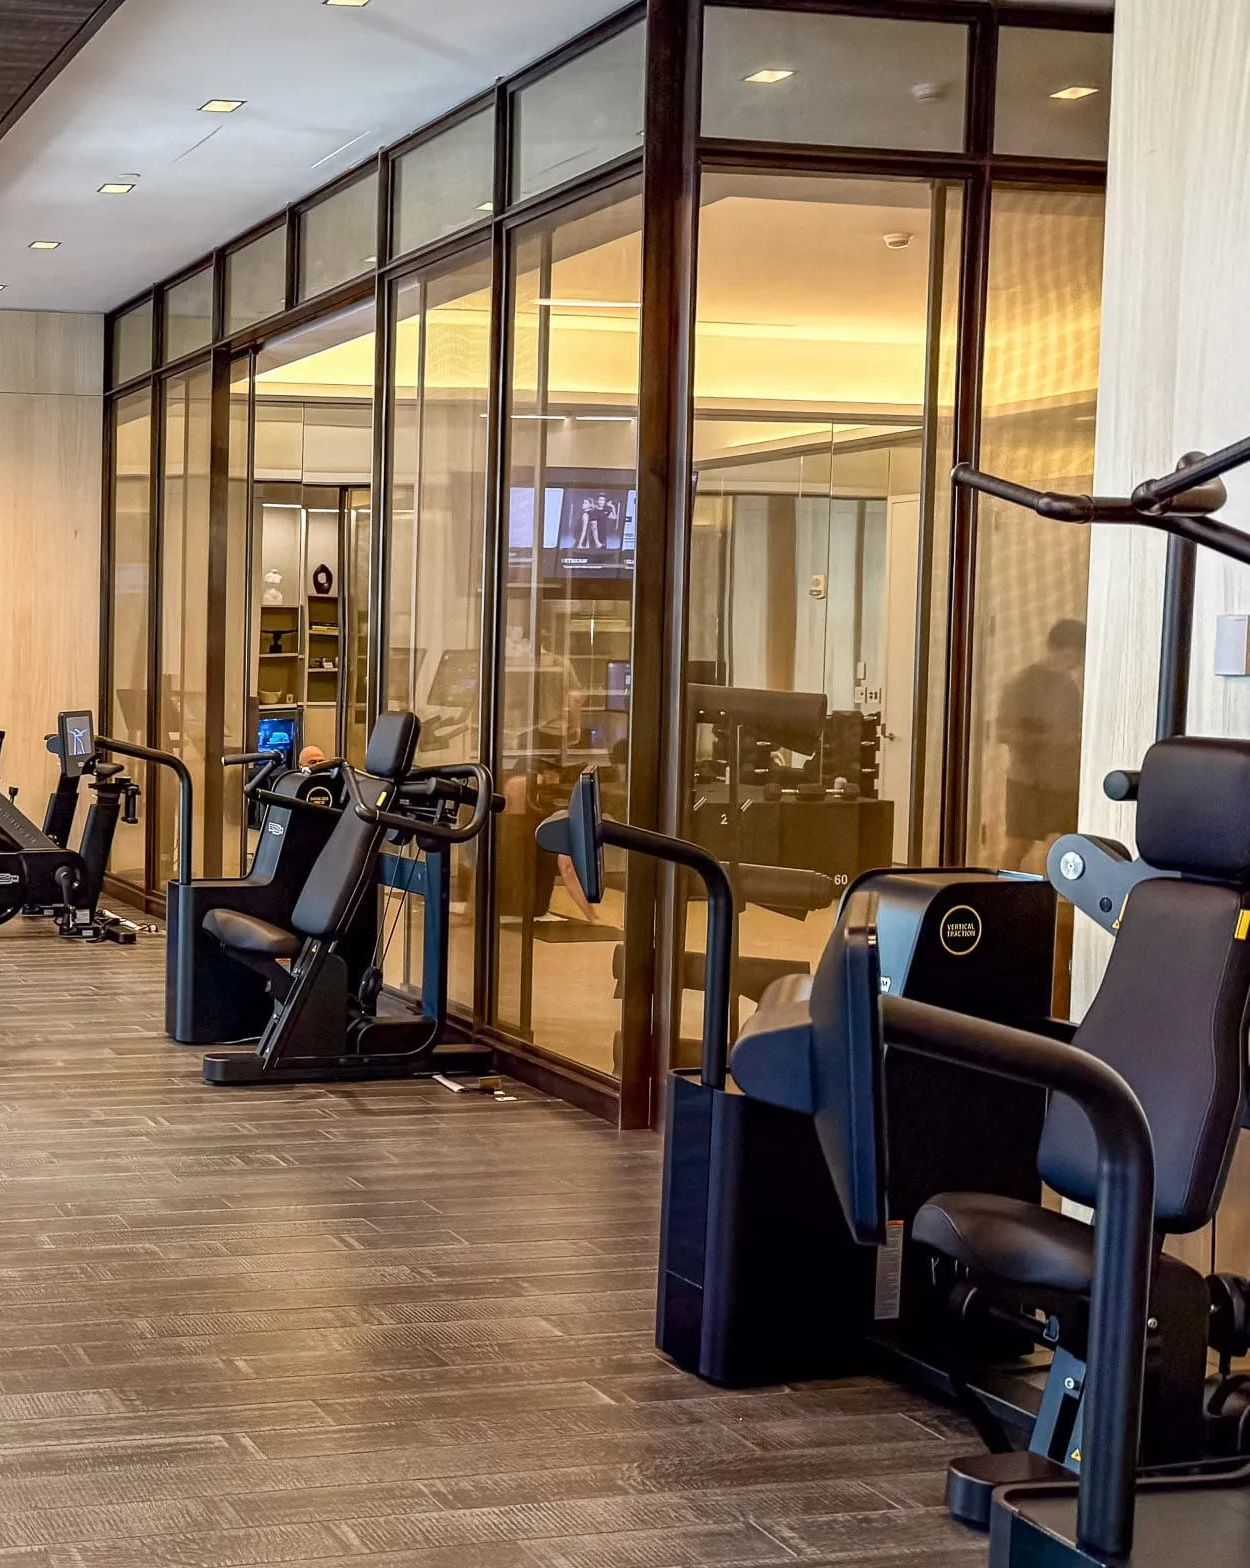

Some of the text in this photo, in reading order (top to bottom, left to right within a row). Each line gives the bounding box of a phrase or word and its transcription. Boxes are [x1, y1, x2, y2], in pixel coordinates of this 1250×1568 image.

[720, 813, 728, 824] 2
[834, 874, 848, 885] 60
[947, 922, 975, 931] VERTICAL
